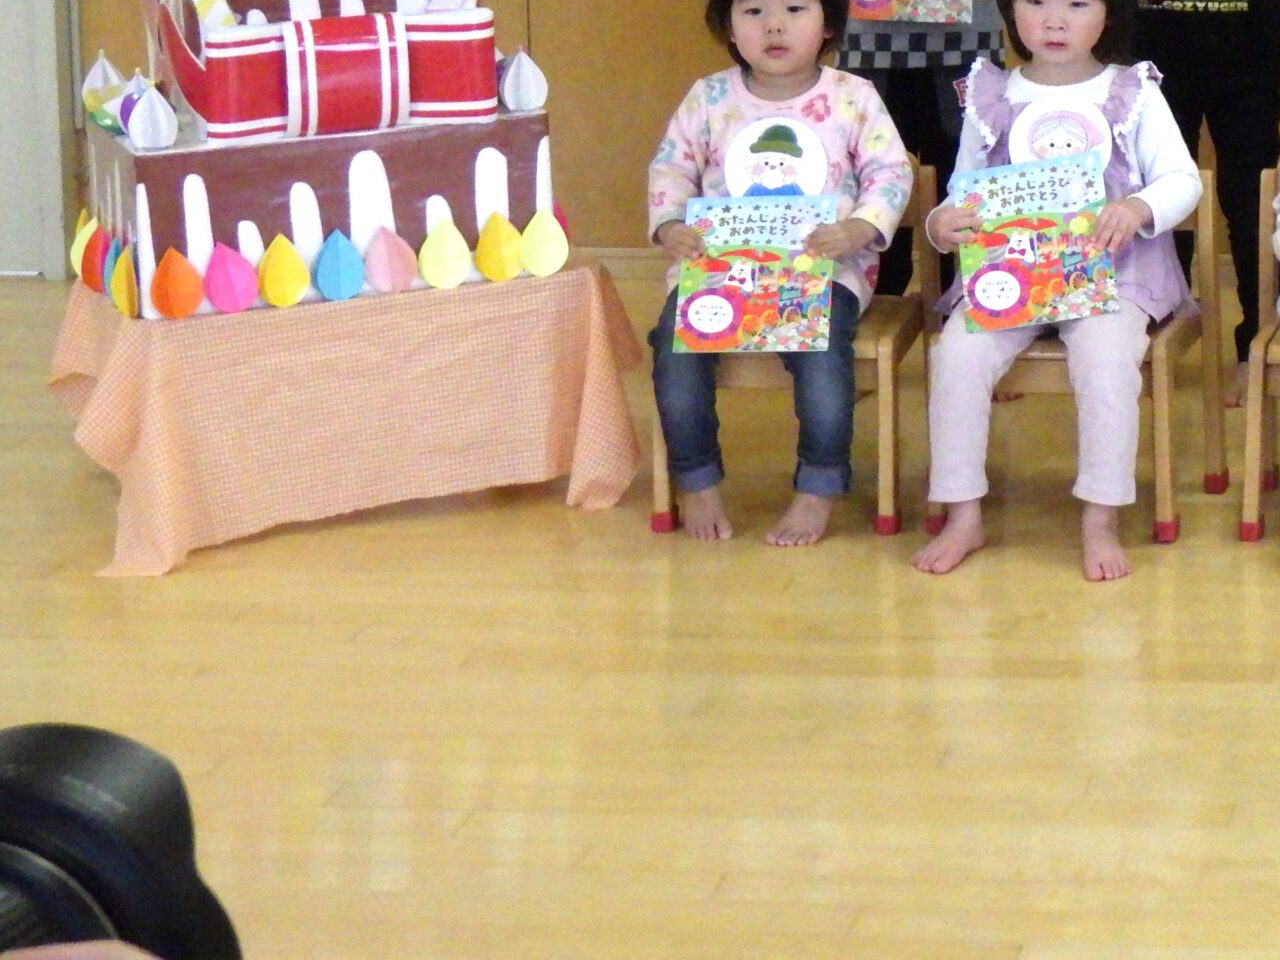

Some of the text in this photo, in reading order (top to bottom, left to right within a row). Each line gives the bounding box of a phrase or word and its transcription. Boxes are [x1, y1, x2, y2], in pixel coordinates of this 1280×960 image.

[987, 176, 1072, 200] おたんじょうび
